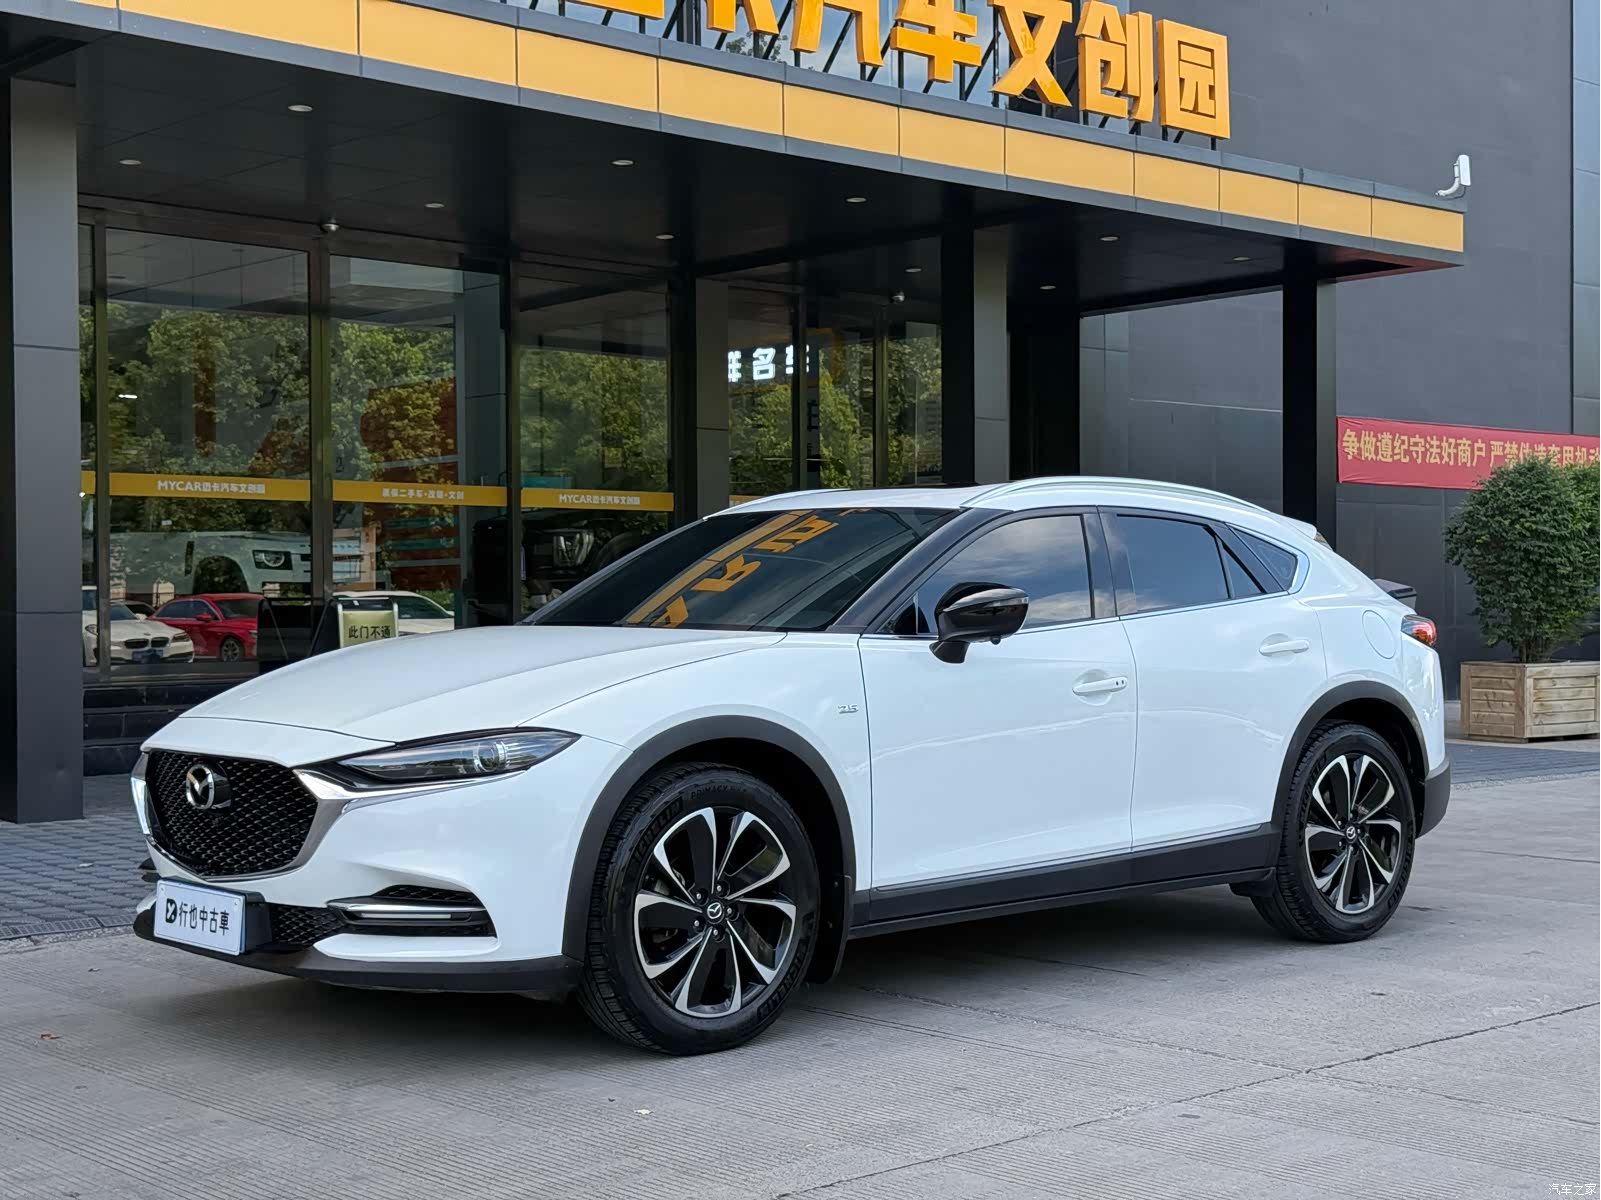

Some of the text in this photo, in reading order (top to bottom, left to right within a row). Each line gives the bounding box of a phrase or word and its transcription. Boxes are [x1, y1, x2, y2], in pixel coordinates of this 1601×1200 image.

[1342, 428, 1487, 467] 争做遵纪守法好商户
[348, 625, 391, 639] 此门不通
[178, 901, 230, 936] 行也中古車
